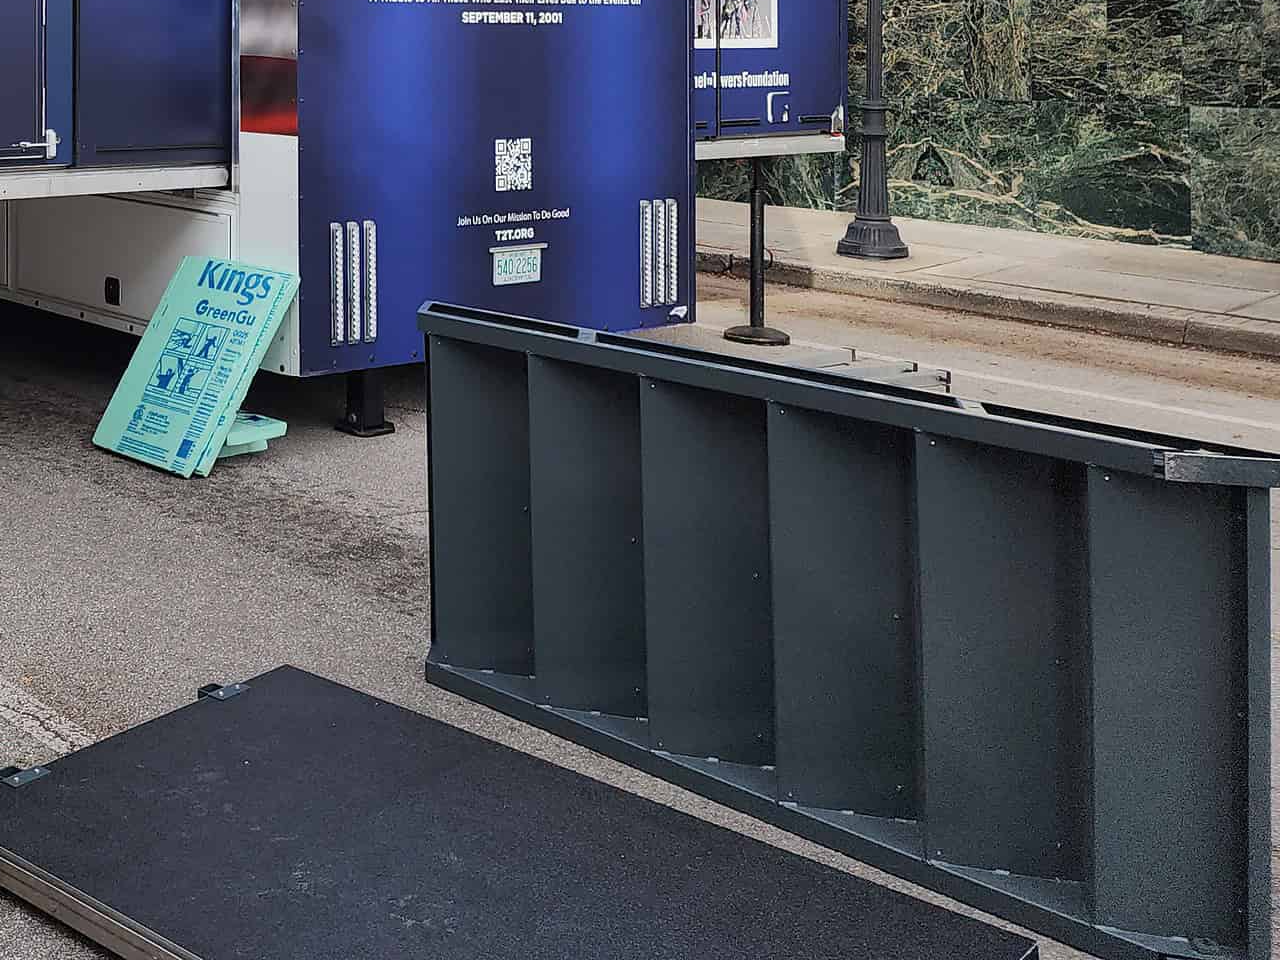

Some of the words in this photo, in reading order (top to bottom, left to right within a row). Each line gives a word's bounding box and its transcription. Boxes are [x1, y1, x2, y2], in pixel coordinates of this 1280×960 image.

[461, 11, 523, 24] SEPTEMBER
[525, 12, 537, 26] 11,
[539, 12, 563, 24] 2001
[712, 71, 742, 89] Twers
[742, 70, 789, 88] Foundation
[456, 216, 472, 227] Join
[472, 215, 482, 225] Us
[482, 214, 493, 224] On
[493, 214, 507, 224] Our
[507, 212, 533, 222] Mission
[532, 210, 541, 220] To
[541, 210, 552, 219] Do
[551, 208, 570, 218] Good
[495, 227, 535, 241] T2T.ORG
[497, 258, 514, 276] 540
[197, 259, 275, 306] Kings
